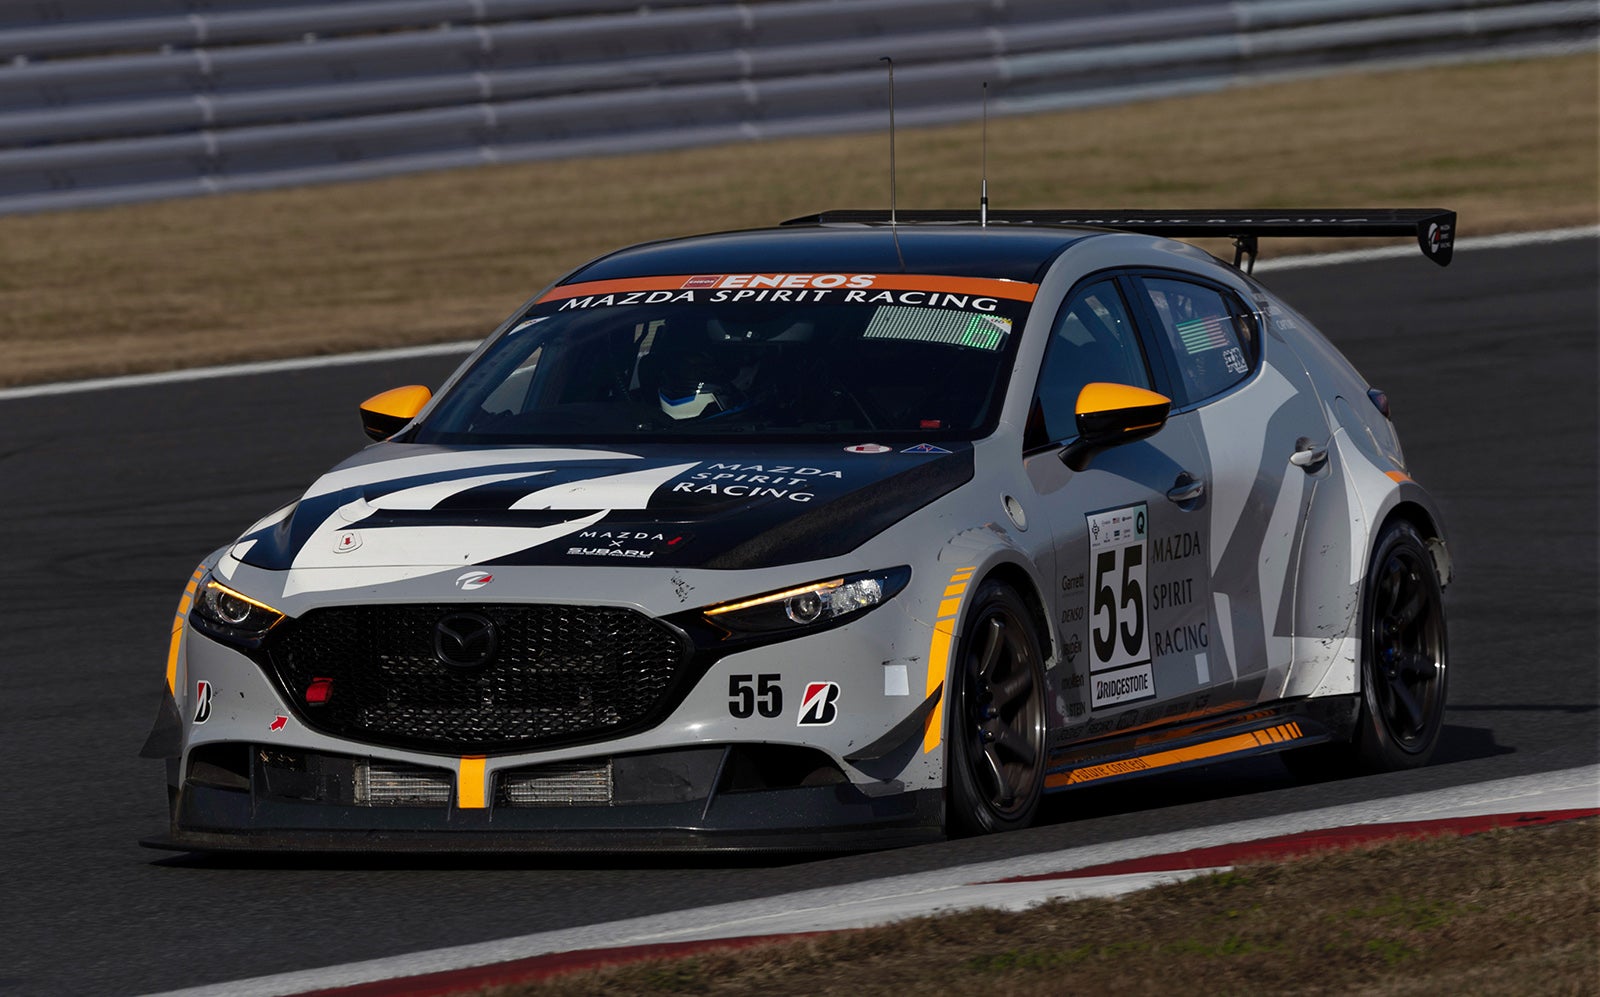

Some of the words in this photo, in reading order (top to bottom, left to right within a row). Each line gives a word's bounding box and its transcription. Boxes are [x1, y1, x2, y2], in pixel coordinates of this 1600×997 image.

[719, 274, 877, 289] ENEOS
[558, 289, 695, 311] MAZDA
[710, 289, 832, 302] SPIRIT
[844, 289, 998, 312] RACING
[691, 472, 807, 486] SPIRIT
[706, 463, 842, 479] MAZDA
[672, 482, 815, 502] RACING
[1136, 511, 1145, 534] Q
[579, 531, 664, 541] MAZDA
[567, 547, 654, 557] SUBARU
[1152, 531, 1201, 563] MAZDA
[1061, 573, 1085, 591] Garrett
[1092, 544, 1145, 663] 55
[1153, 578, 1193, 610] SPIRIT
[1061, 606, 1083, 623] DENSO
[1154, 622, 1208, 657] RACING
[729, 674, 783, 719] 55
[1096, 673, 1149, 700] BRIDGESTONE
[1106, 757, 1151, 774] concept
